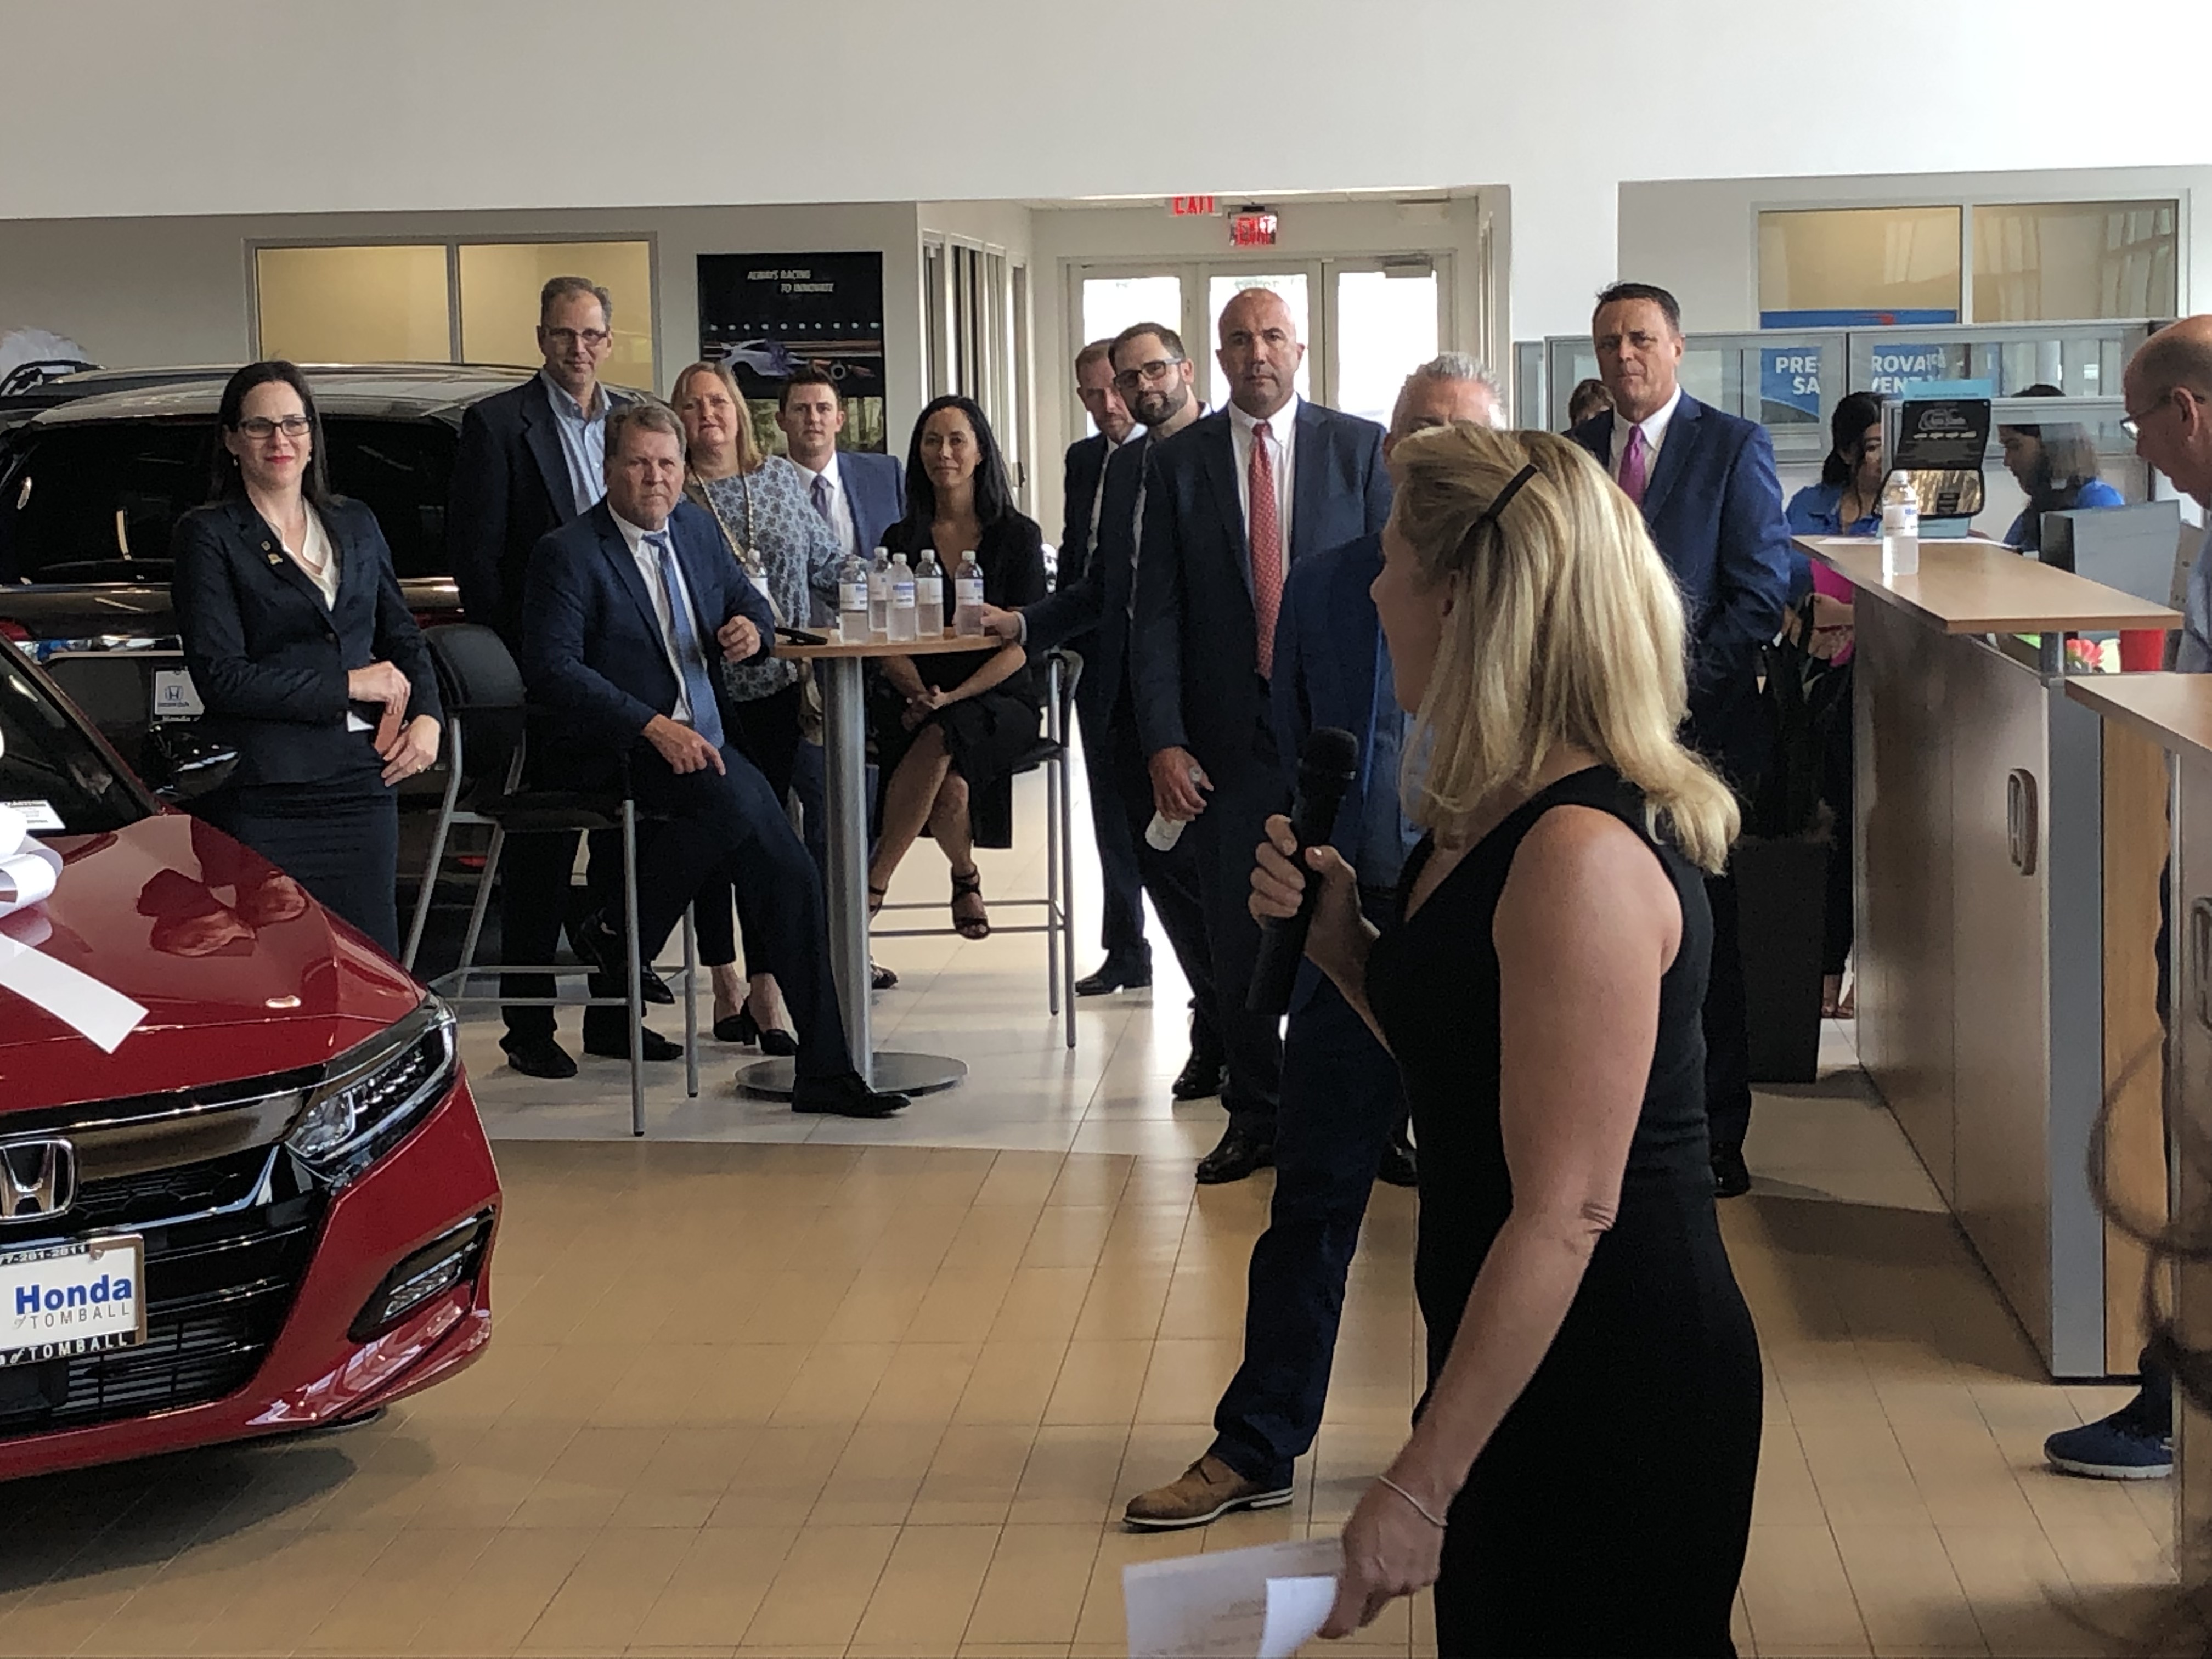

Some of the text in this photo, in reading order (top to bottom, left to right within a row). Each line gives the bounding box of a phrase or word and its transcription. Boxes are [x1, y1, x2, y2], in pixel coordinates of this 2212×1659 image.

[15, 1274, 132, 1316] Honda
[30, 1302, 129, 1329] TOMBALL
[29, 1332, 128, 1361] TOMBALL
